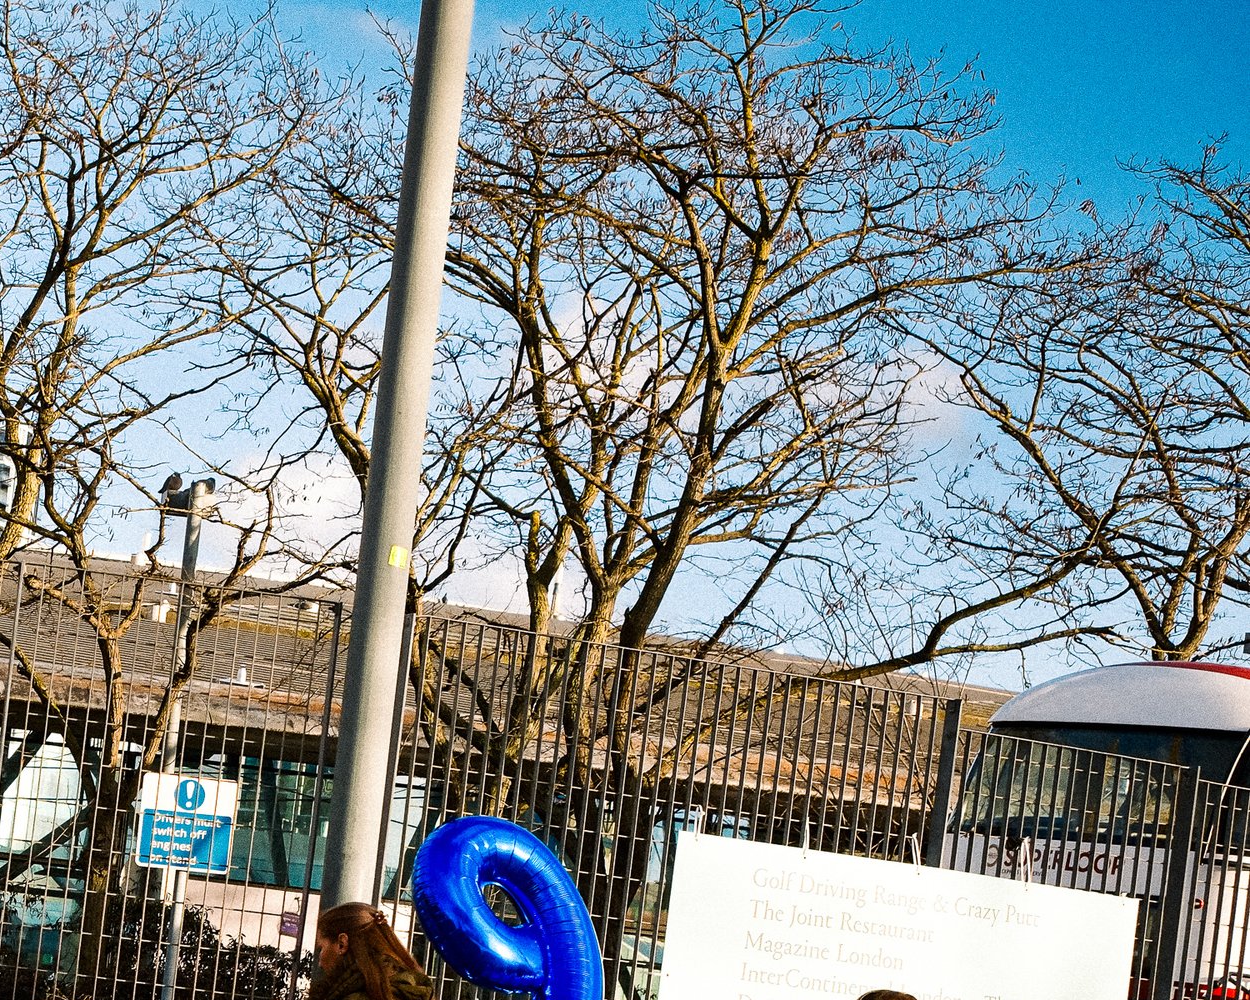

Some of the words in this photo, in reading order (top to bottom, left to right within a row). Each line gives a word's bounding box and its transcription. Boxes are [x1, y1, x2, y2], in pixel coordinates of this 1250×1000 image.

[152, 825, 187, 839] switch
[189, 830, 207, 840] off
[154, 812, 190, 826] Drivers
[193, 817, 222, 828] must
[150, 853, 163, 862] on
[166, 853, 197, 866] stand
[151, 840, 192, 853] engines
[1003, 847, 1122, 876] SPRLOO
[752, 867, 796, 890] Golf
[798, 873, 866, 909] Driving
[873, 885, 926, 915] Range
[933, 893, 950, 913] &
[954, 897, 1000, 928] Crazy
[1005, 904, 1041, 928] Putt
[750, 898, 784, 924] The
[788, 905, 834, 929] Joint
[840, 911, 935, 943] Restaurant
[744, 930, 831, 961] Magazine
[837, 943, 904, 970] London
[739, 962, 872, 997] InterContinen
